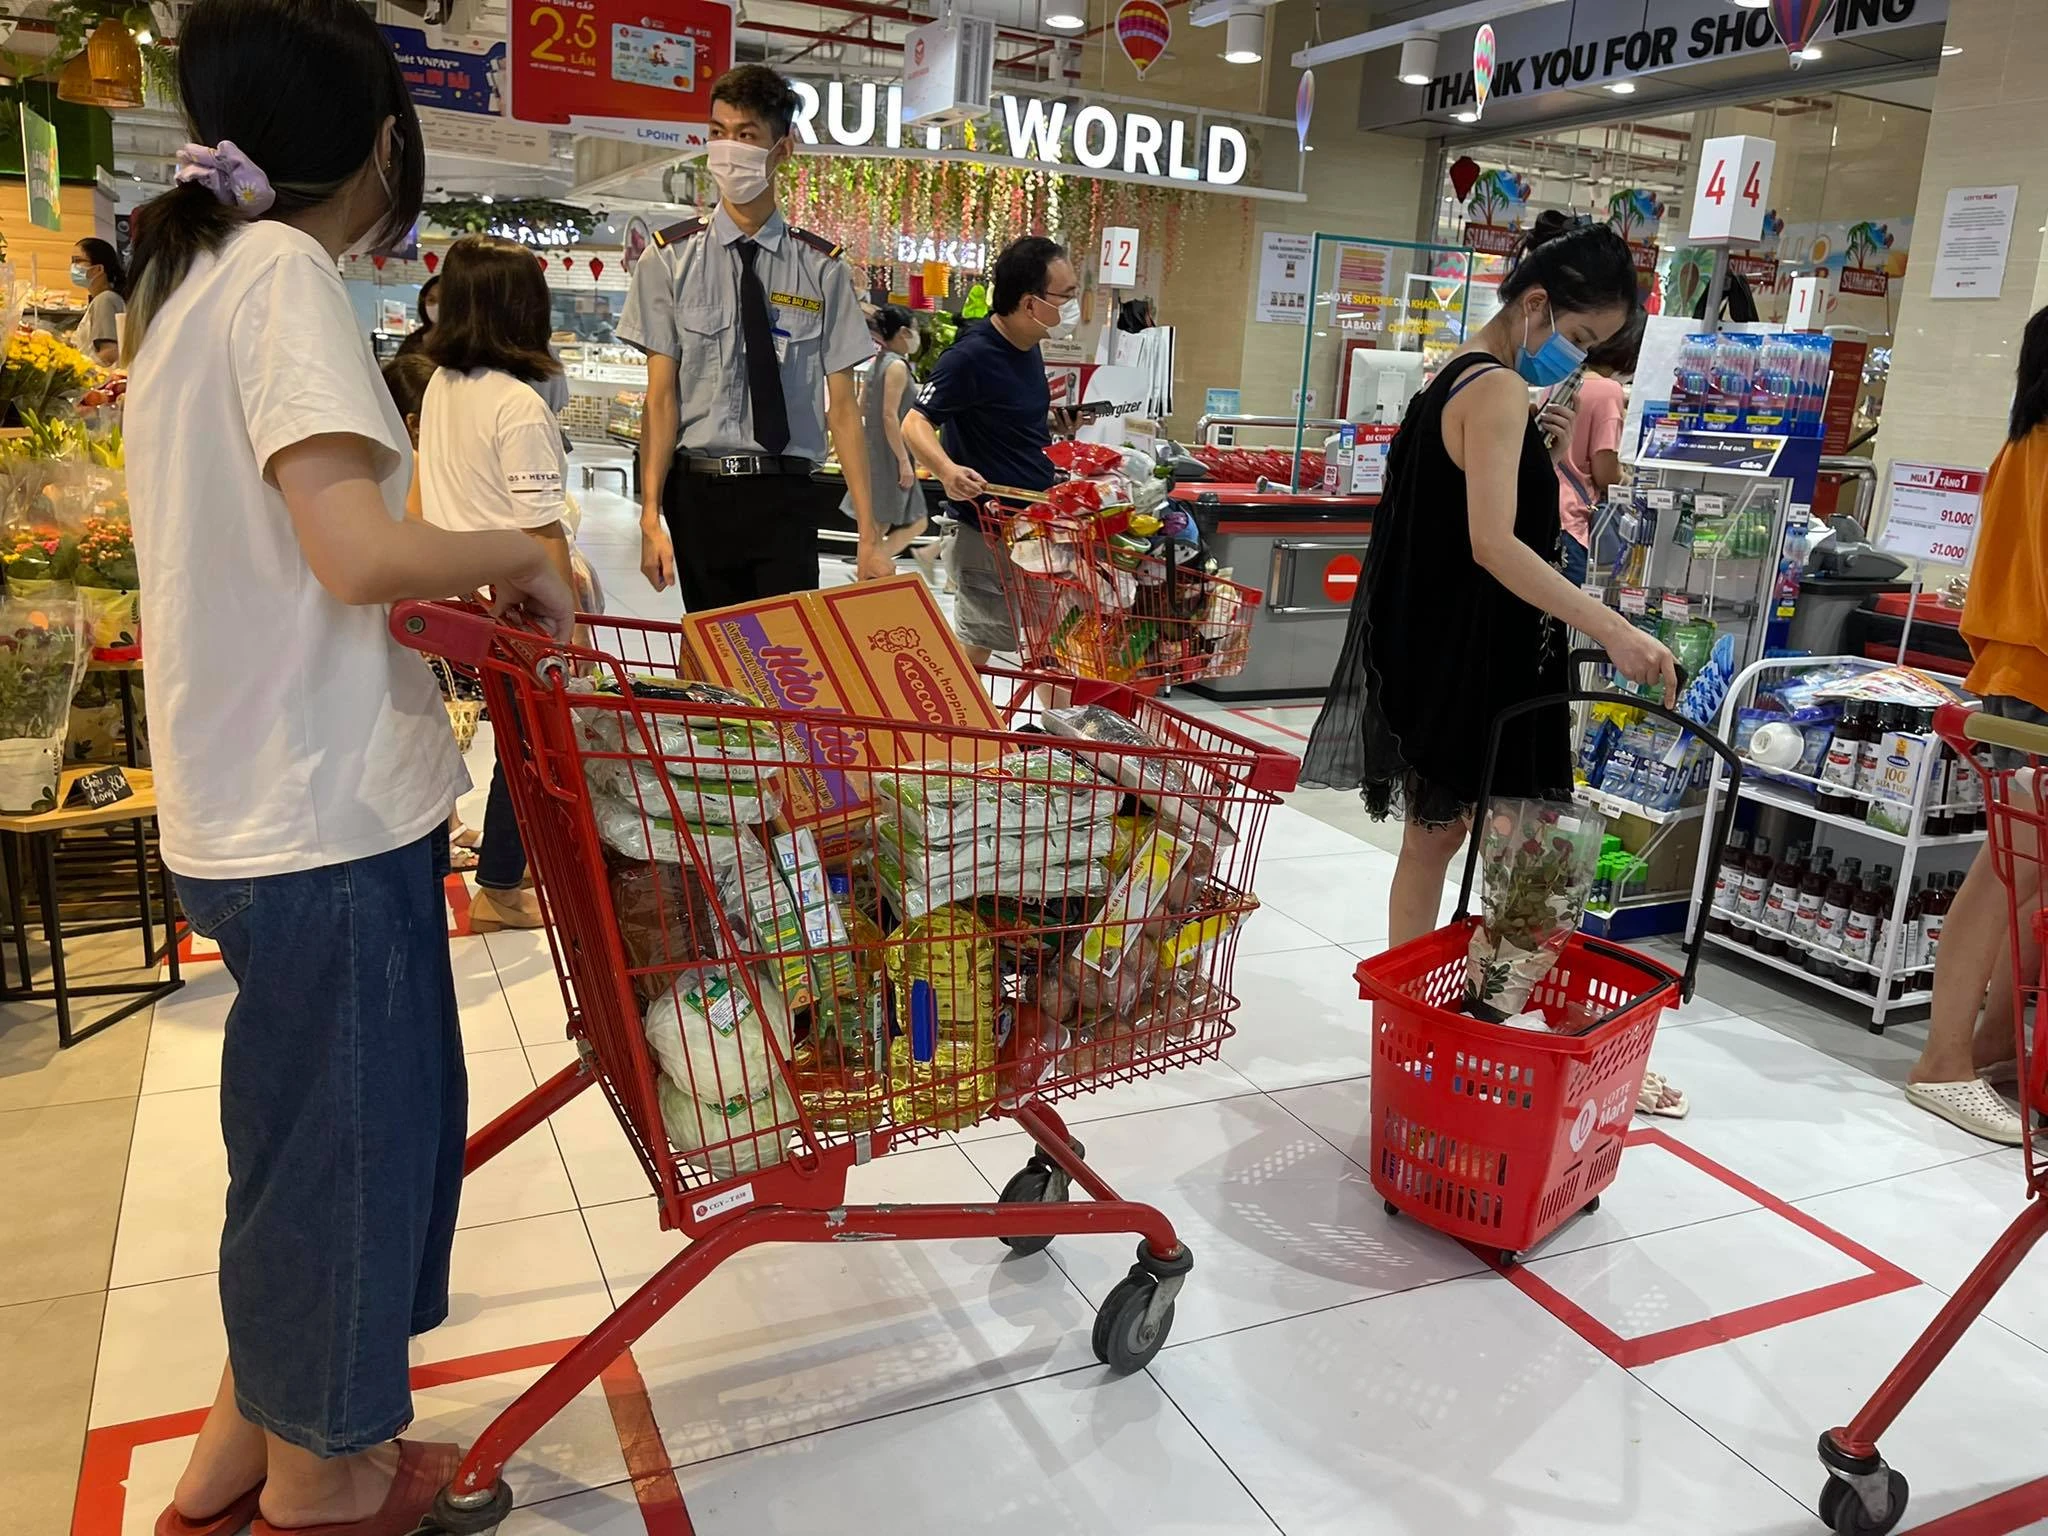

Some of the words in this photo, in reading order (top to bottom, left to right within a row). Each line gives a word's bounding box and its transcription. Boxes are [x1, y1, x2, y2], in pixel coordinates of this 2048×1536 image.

[530, 6, 597, 62] 2.5
[1530, 41, 1598, 91] YOU
[1602, 26, 1677, 77] FOR
[1687, 0, 1916, 59] SHOING
[637, 127, 680, 142] L.POINT
[792, 81, 942, 149] RUI
[1002, 95, 1248, 185] WORLD
[1705, 160, 1725, 205] 4
[1743, 161, 1760, 208] 4
[1466, 227, 1518, 252] SUMME
[1104, 240, 1111, 267] 2
[1119, 240, 1130, 267] 2
[1843, 271, 1886, 294] SUMMER
[1800, 289, 1806, 313] 1
[1818, 289, 1824, 313] 1
[1095, 401, 1142, 418] rgizer
[1718, 441, 1724, 450] 1
[1910, 473, 1927, 483] MUA
[1927, 470, 1936, 484] 1
[1940, 476, 1961, 488] TẶNG
[1960, 475, 1969, 489] 1
[1940, 509, 1974, 525] 91.000
[759, 645, 824, 704] Hảo
[916, 648, 944, 677] Cook
[940, 677, 968, 727] happine
[898, 660, 943, 728] Acecoo
[1602, 1080, 1632, 1108] LOTTE
[1597, 1096, 1628, 1131] Mart
